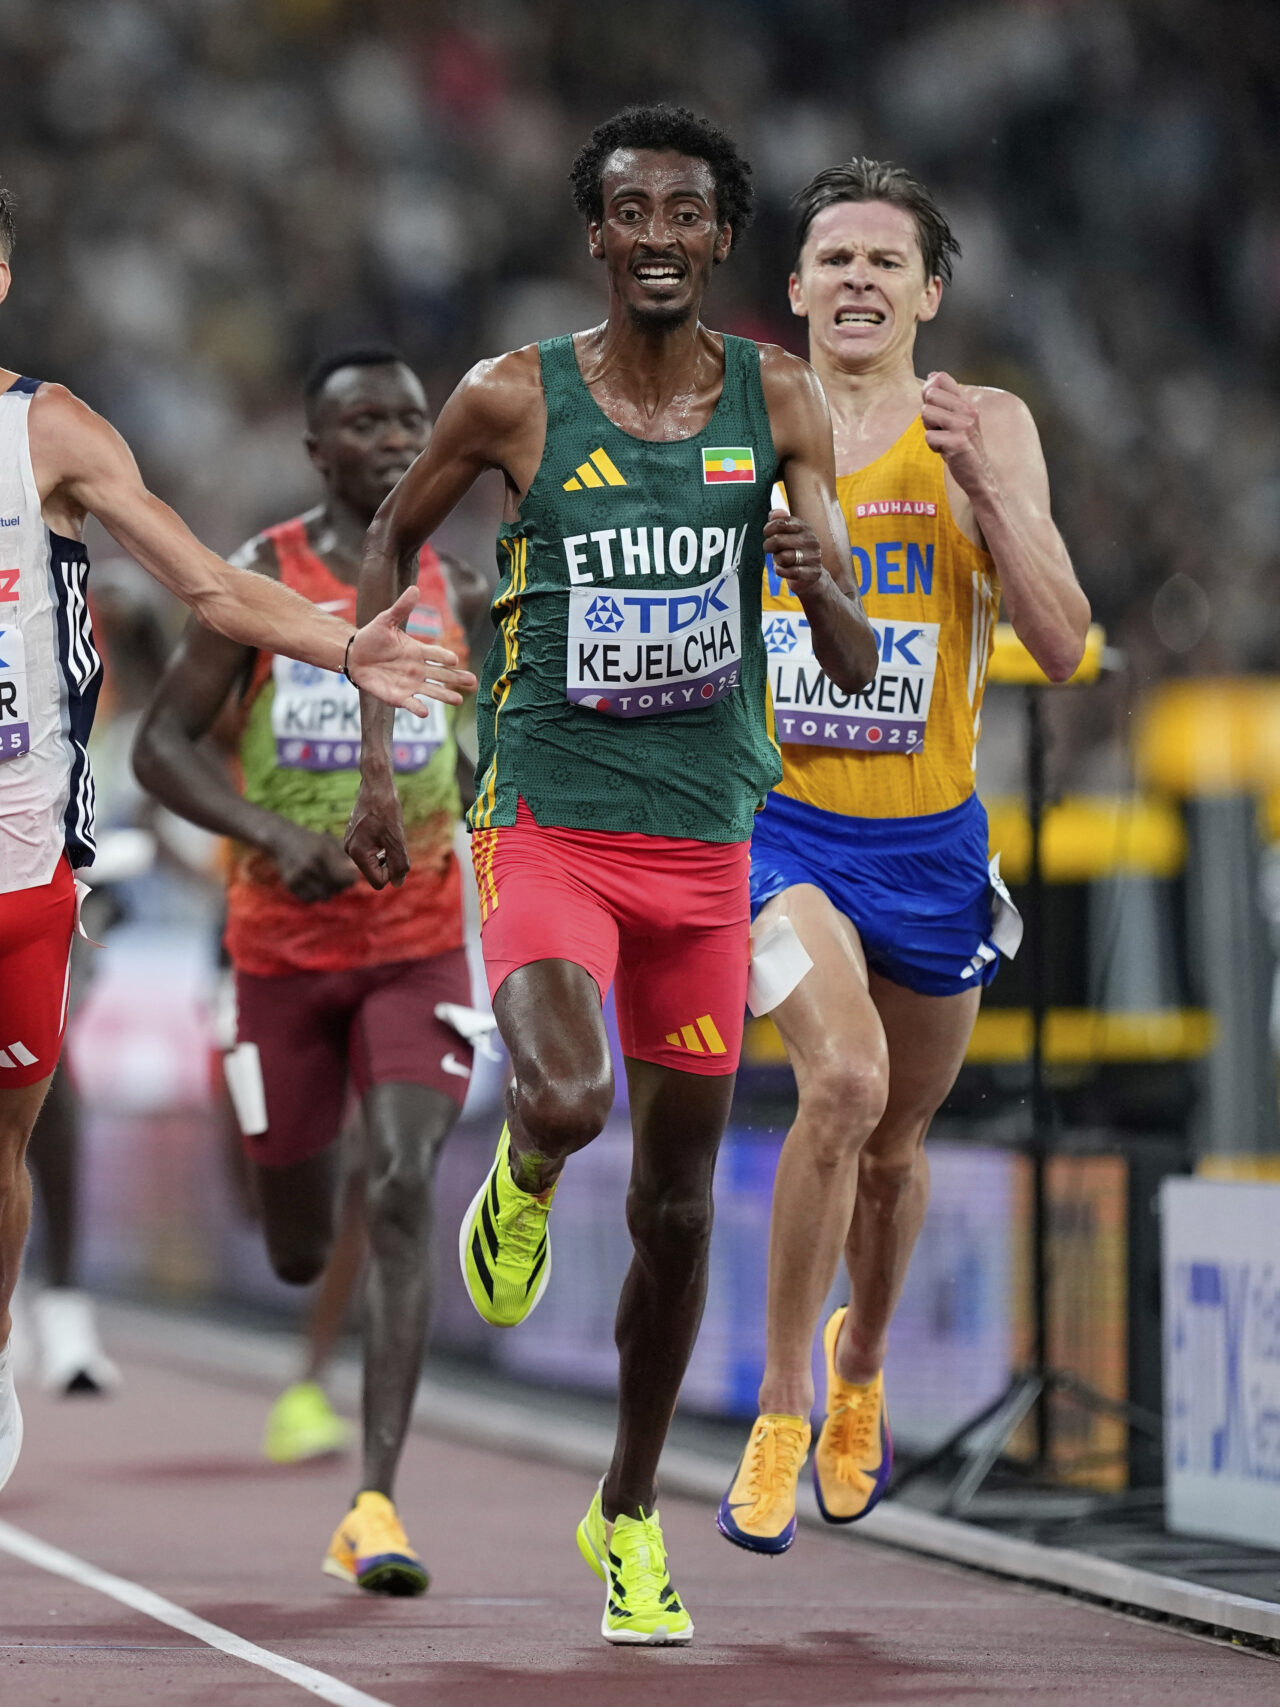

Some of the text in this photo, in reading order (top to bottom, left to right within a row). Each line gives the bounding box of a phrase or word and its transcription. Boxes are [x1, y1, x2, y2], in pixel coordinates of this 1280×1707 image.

[856, 502, 936, 517] BAUHAUS
[624, 578, 729, 634] TDK
[578, 620, 736, 683] KEJELCHA
